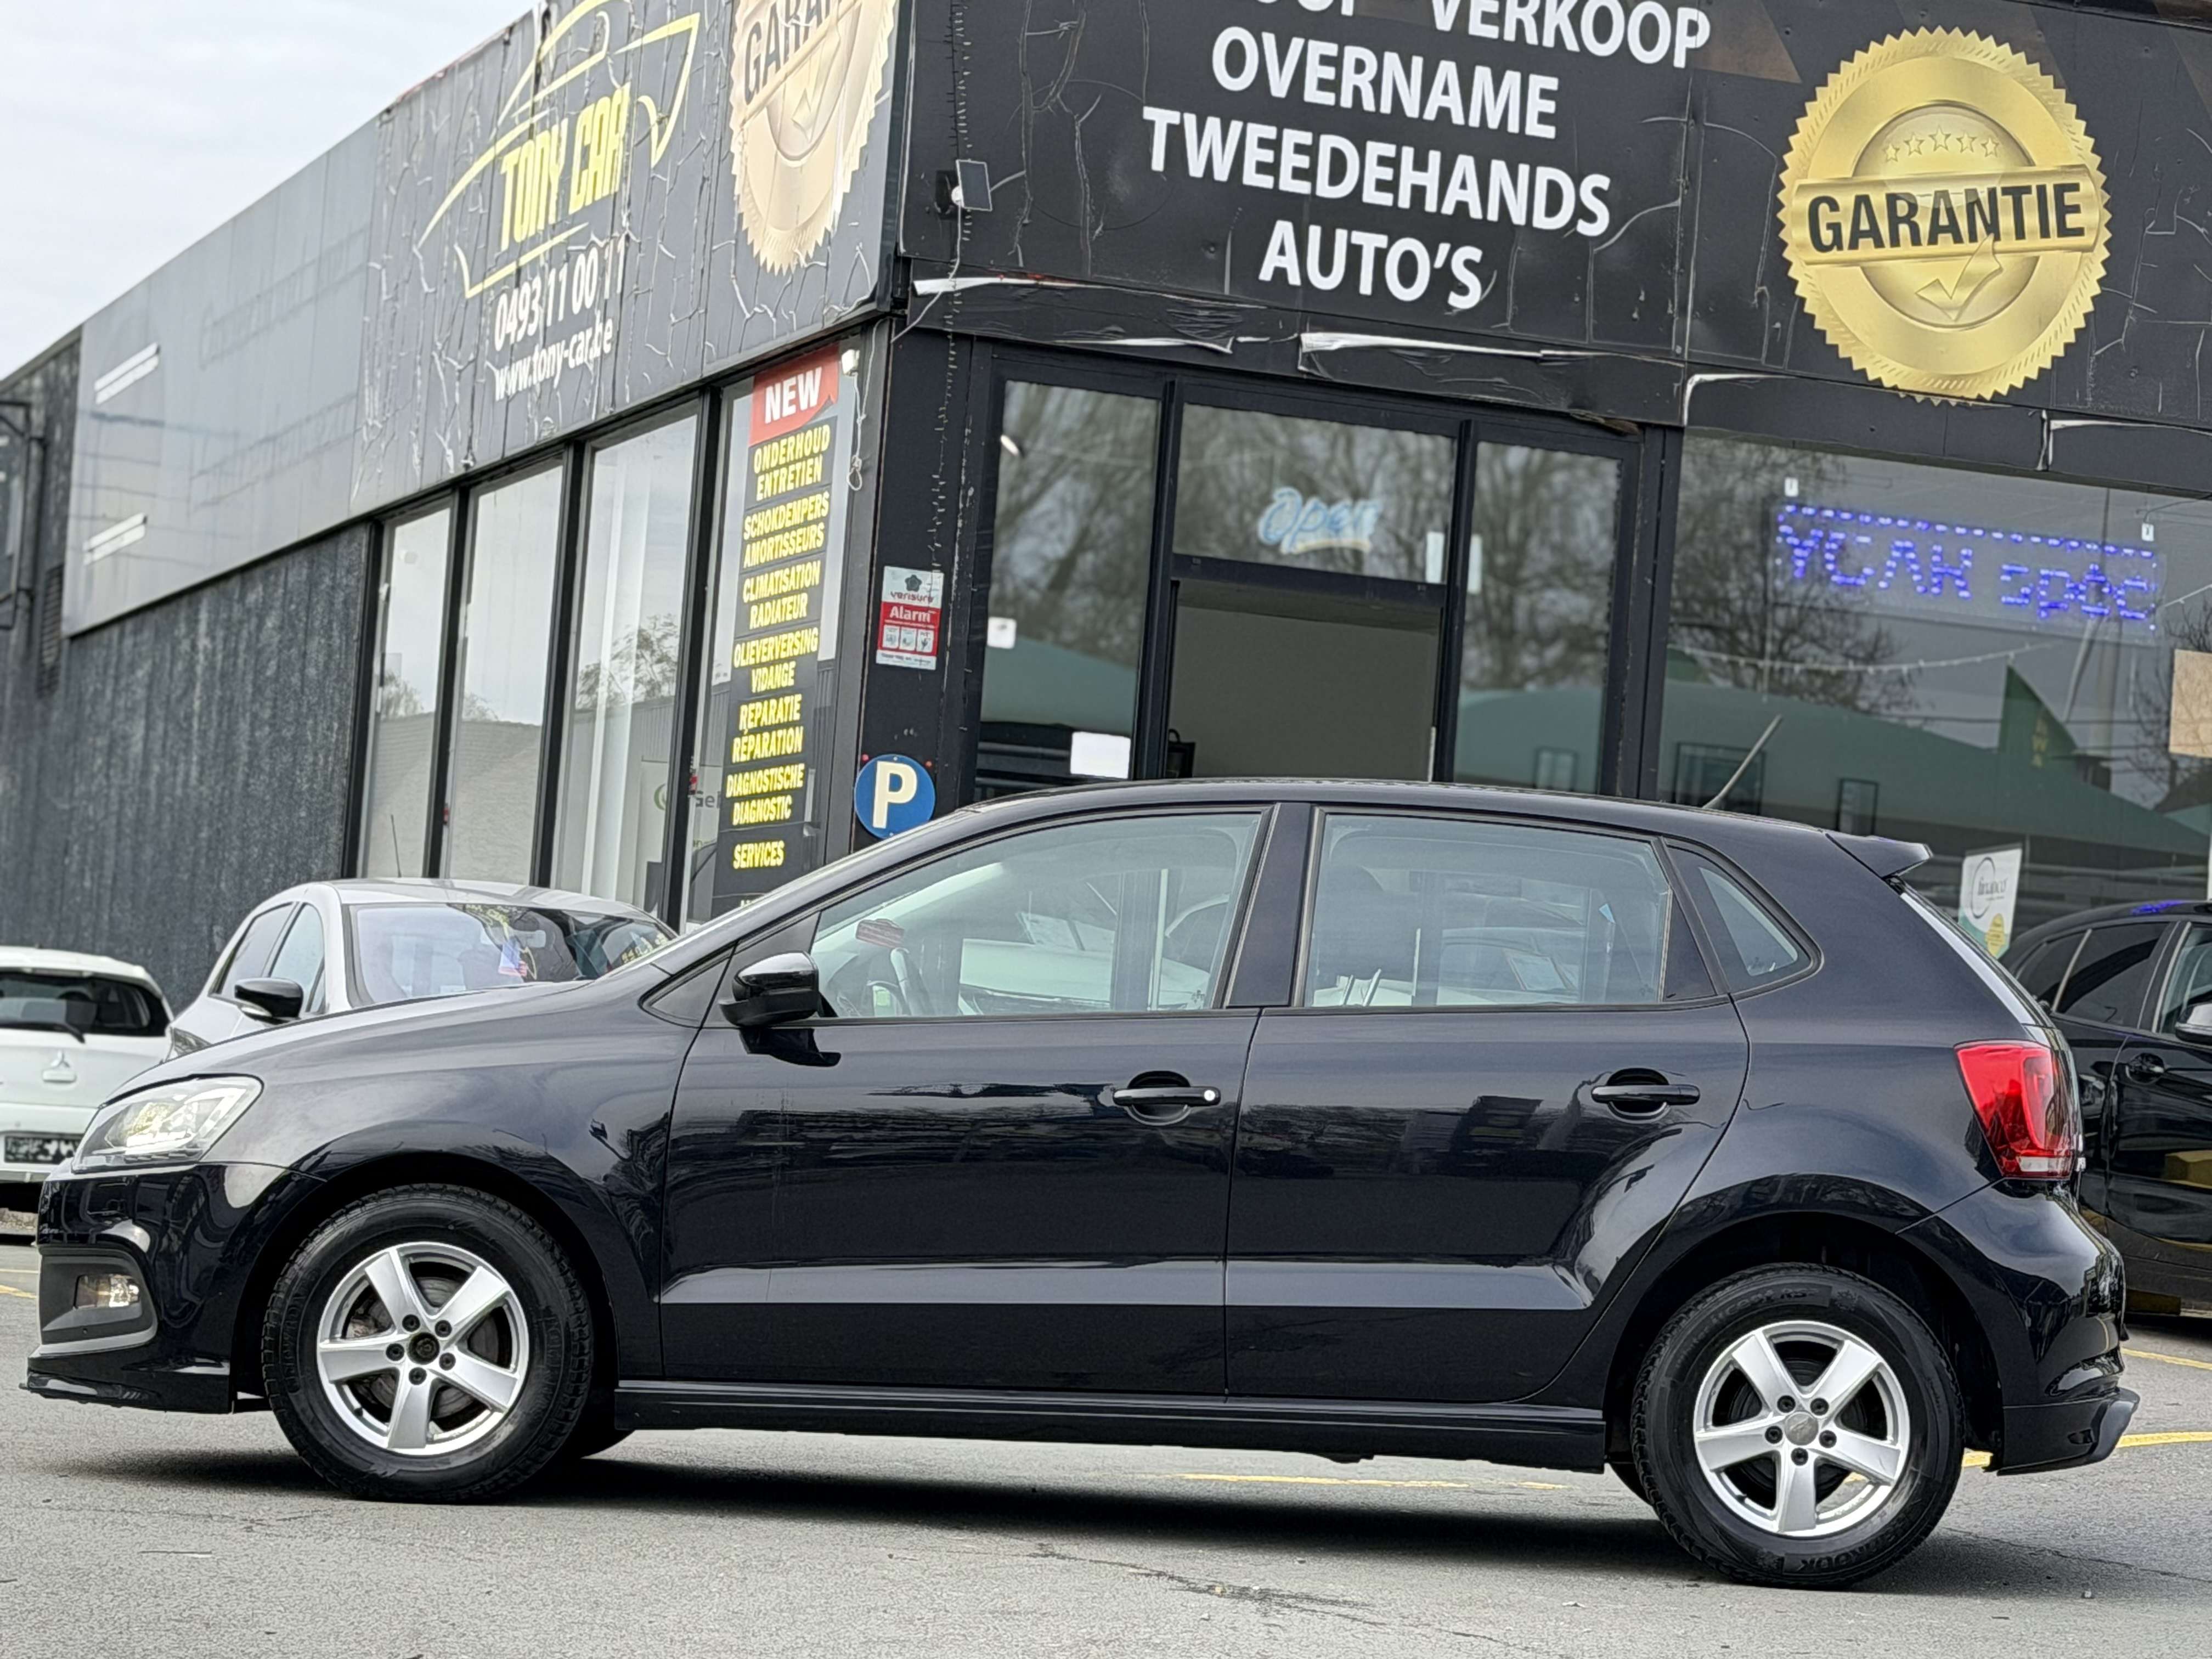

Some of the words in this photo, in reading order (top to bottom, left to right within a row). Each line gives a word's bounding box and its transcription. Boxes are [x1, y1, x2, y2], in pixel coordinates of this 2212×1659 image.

[1431, 0, 1711, 69] VERKOOP
[1212, 27, 1559, 138] OVERNAME
[500, 117, 568, 251] TONY
[569, 81, 631, 215] CAR
[1143, 106, 1611, 236] TWEEDEHANDS
[1808, 183, 2085, 252] GARANTIE
[1259, 221, 1482, 309] AUTO'S
[494, 275, 541, 352] 0493
[546, 262, 568, 328] 11
[572, 247, 598, 315] 00
[494, 309, 613, 402] www.tony-car.be
[764, 366, 822, 424] NEW
[754, 425, 831, 473] ONDERHOUD
[756, 455, 823, 501] ENTRETIEN
[743, 491, 830, 540] SCHOKDEMPERS
[743, 522, 825, 569] AMORTISSEURS
[742, 560, 821, 603] CLIMATISATION
[749, 592, 808, 630] RADIATEUR
[889, 605, 931, 623] Alarm
[733, 627, 819, 668] OLIEVERVERSING
[751, 661, 797, 693] VIDANGE
[739, 693, 802, 731] REPARATIE
[725, 763, 805, 798] DIAGNOSTISCHE
[872, 760, 918, 829] P
[732, 795, 792, 826] DIAGNOSTIC
[733, 840, 785, 870] SERVICES
